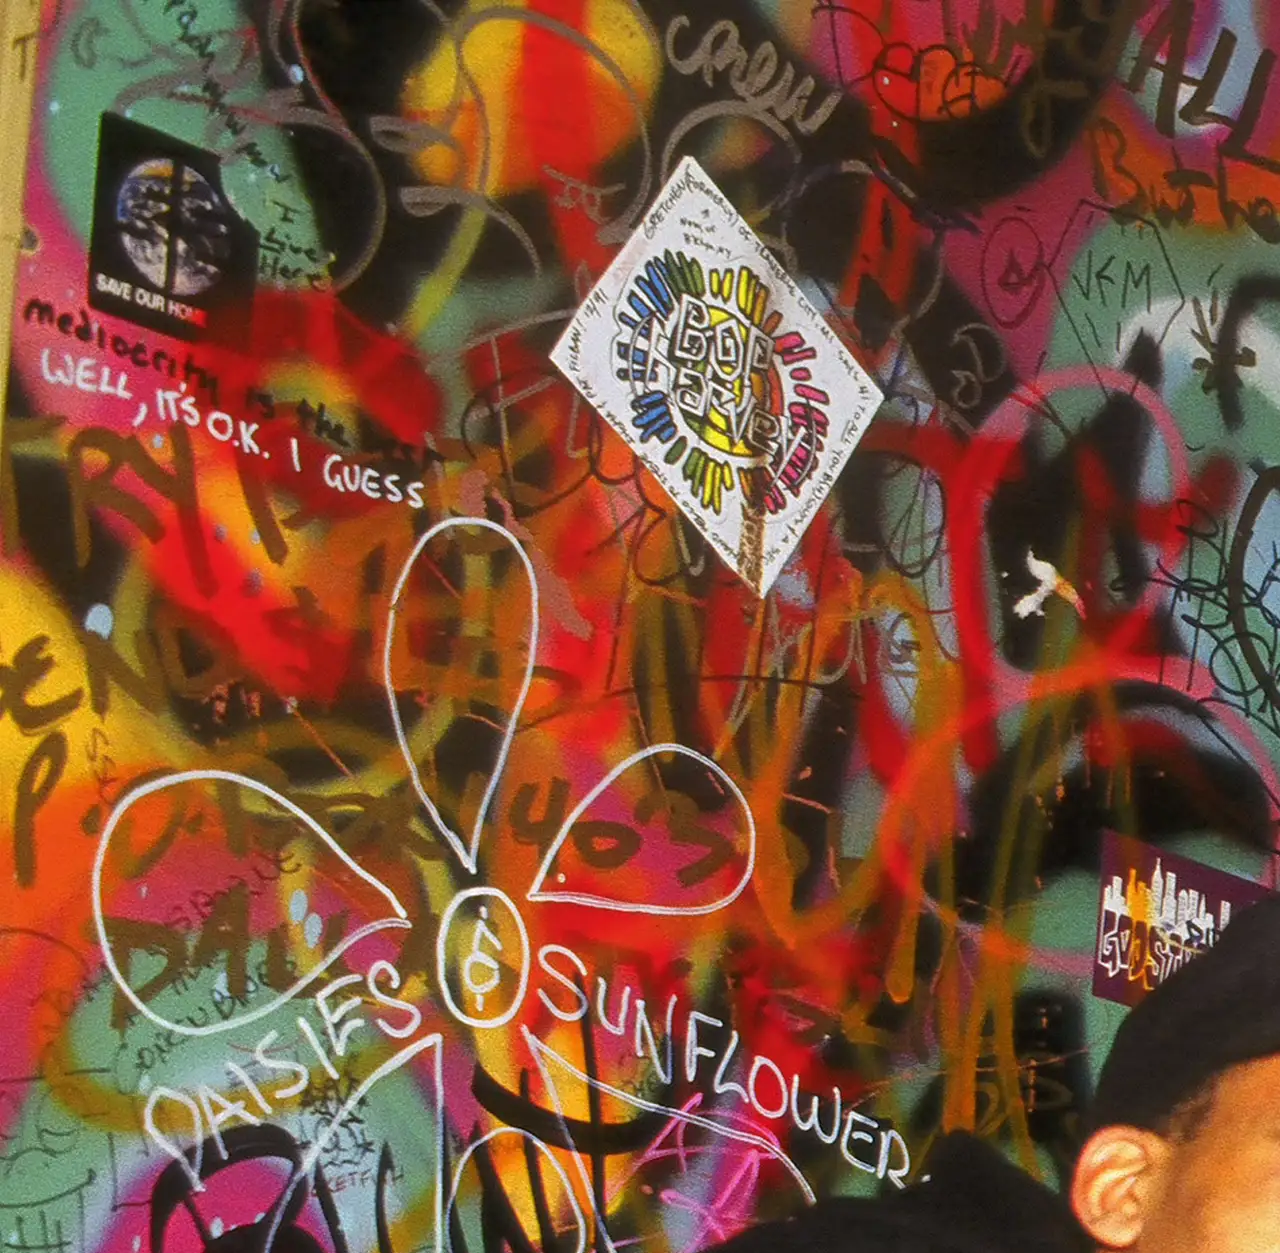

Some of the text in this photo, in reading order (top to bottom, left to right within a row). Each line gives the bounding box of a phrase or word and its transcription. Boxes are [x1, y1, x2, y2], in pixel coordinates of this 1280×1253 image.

[95, 272, 207, 322] SAVE OUR HO
[323, 453, 425, 509] GUESS
